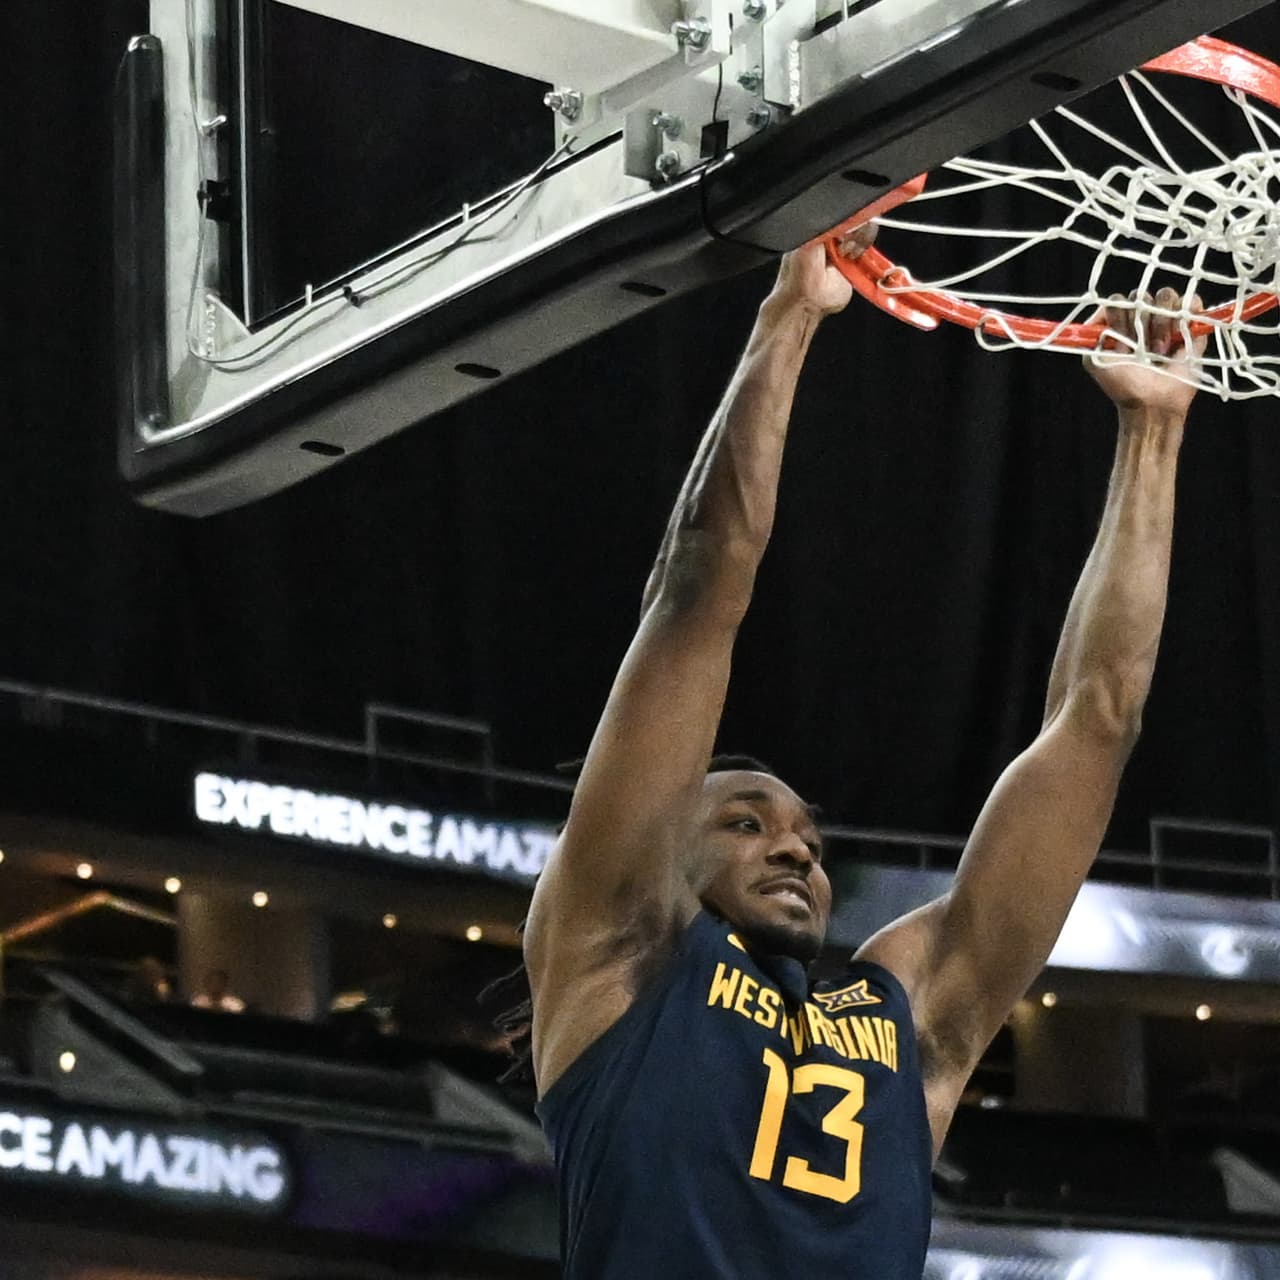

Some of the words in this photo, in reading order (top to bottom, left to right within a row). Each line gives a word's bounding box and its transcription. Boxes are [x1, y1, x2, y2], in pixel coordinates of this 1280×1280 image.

[194, 771, 433, 860] EXPERIENCE
[434, 814, 559, 876] AMAZ
[787, 1001, 898, 1073] VRGINIA
[55, 1122, 286, 1203] AMAZING
[748, 1047, 866, 1204] 13
